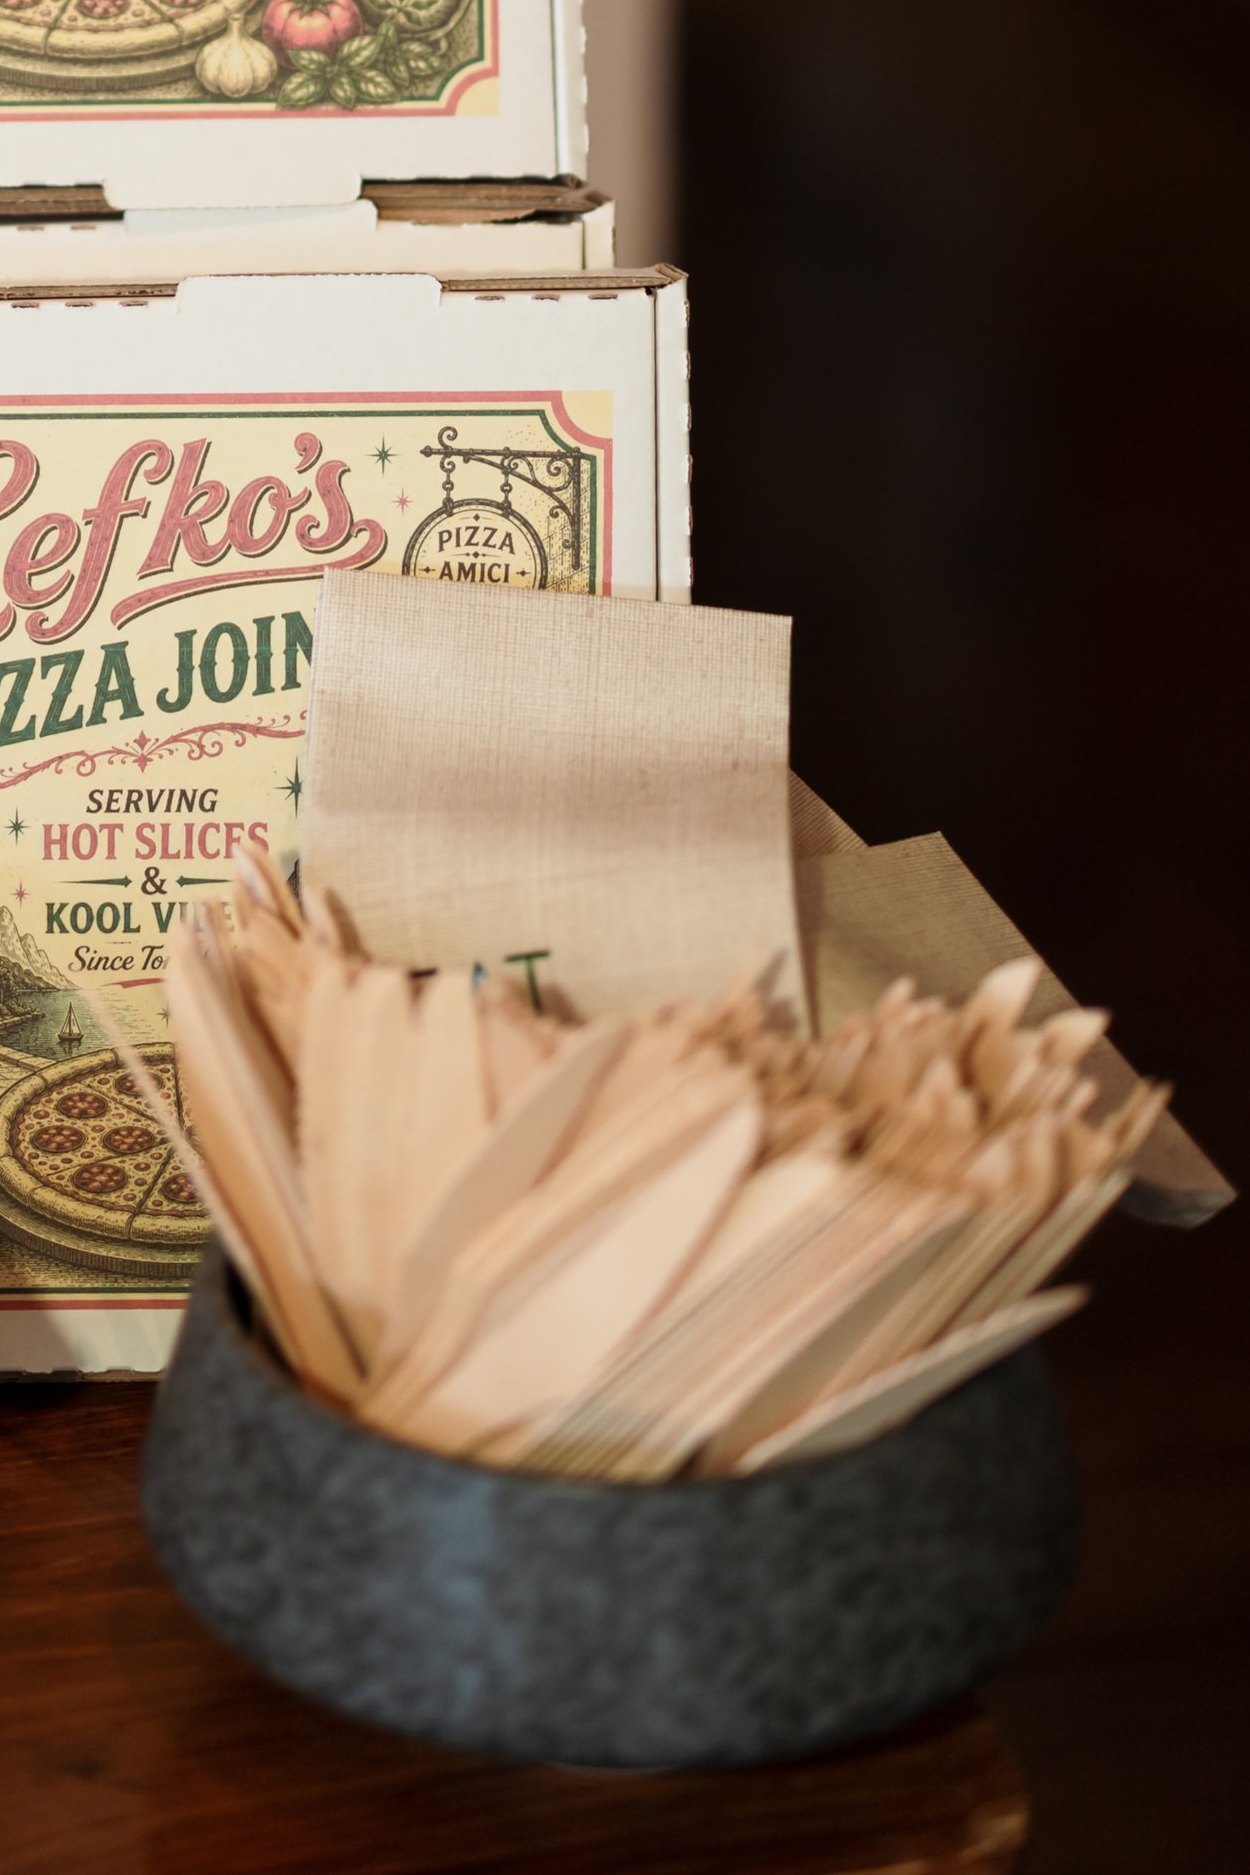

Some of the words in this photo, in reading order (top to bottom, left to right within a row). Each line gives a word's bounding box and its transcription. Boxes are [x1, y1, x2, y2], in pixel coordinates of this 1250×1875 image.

[438, 525, 516, 556] PIZZA
[438, 560, 511, 584] AMICI
[156, 610, 317, 713] JOIN
[85, 788, 219, 814] SERVING
[42, 823, 124, 860] HOT
[140, 866, 168, 895] &
[44, 902, 141, 934] KOOL
[67, 945, 135, 973] Since
